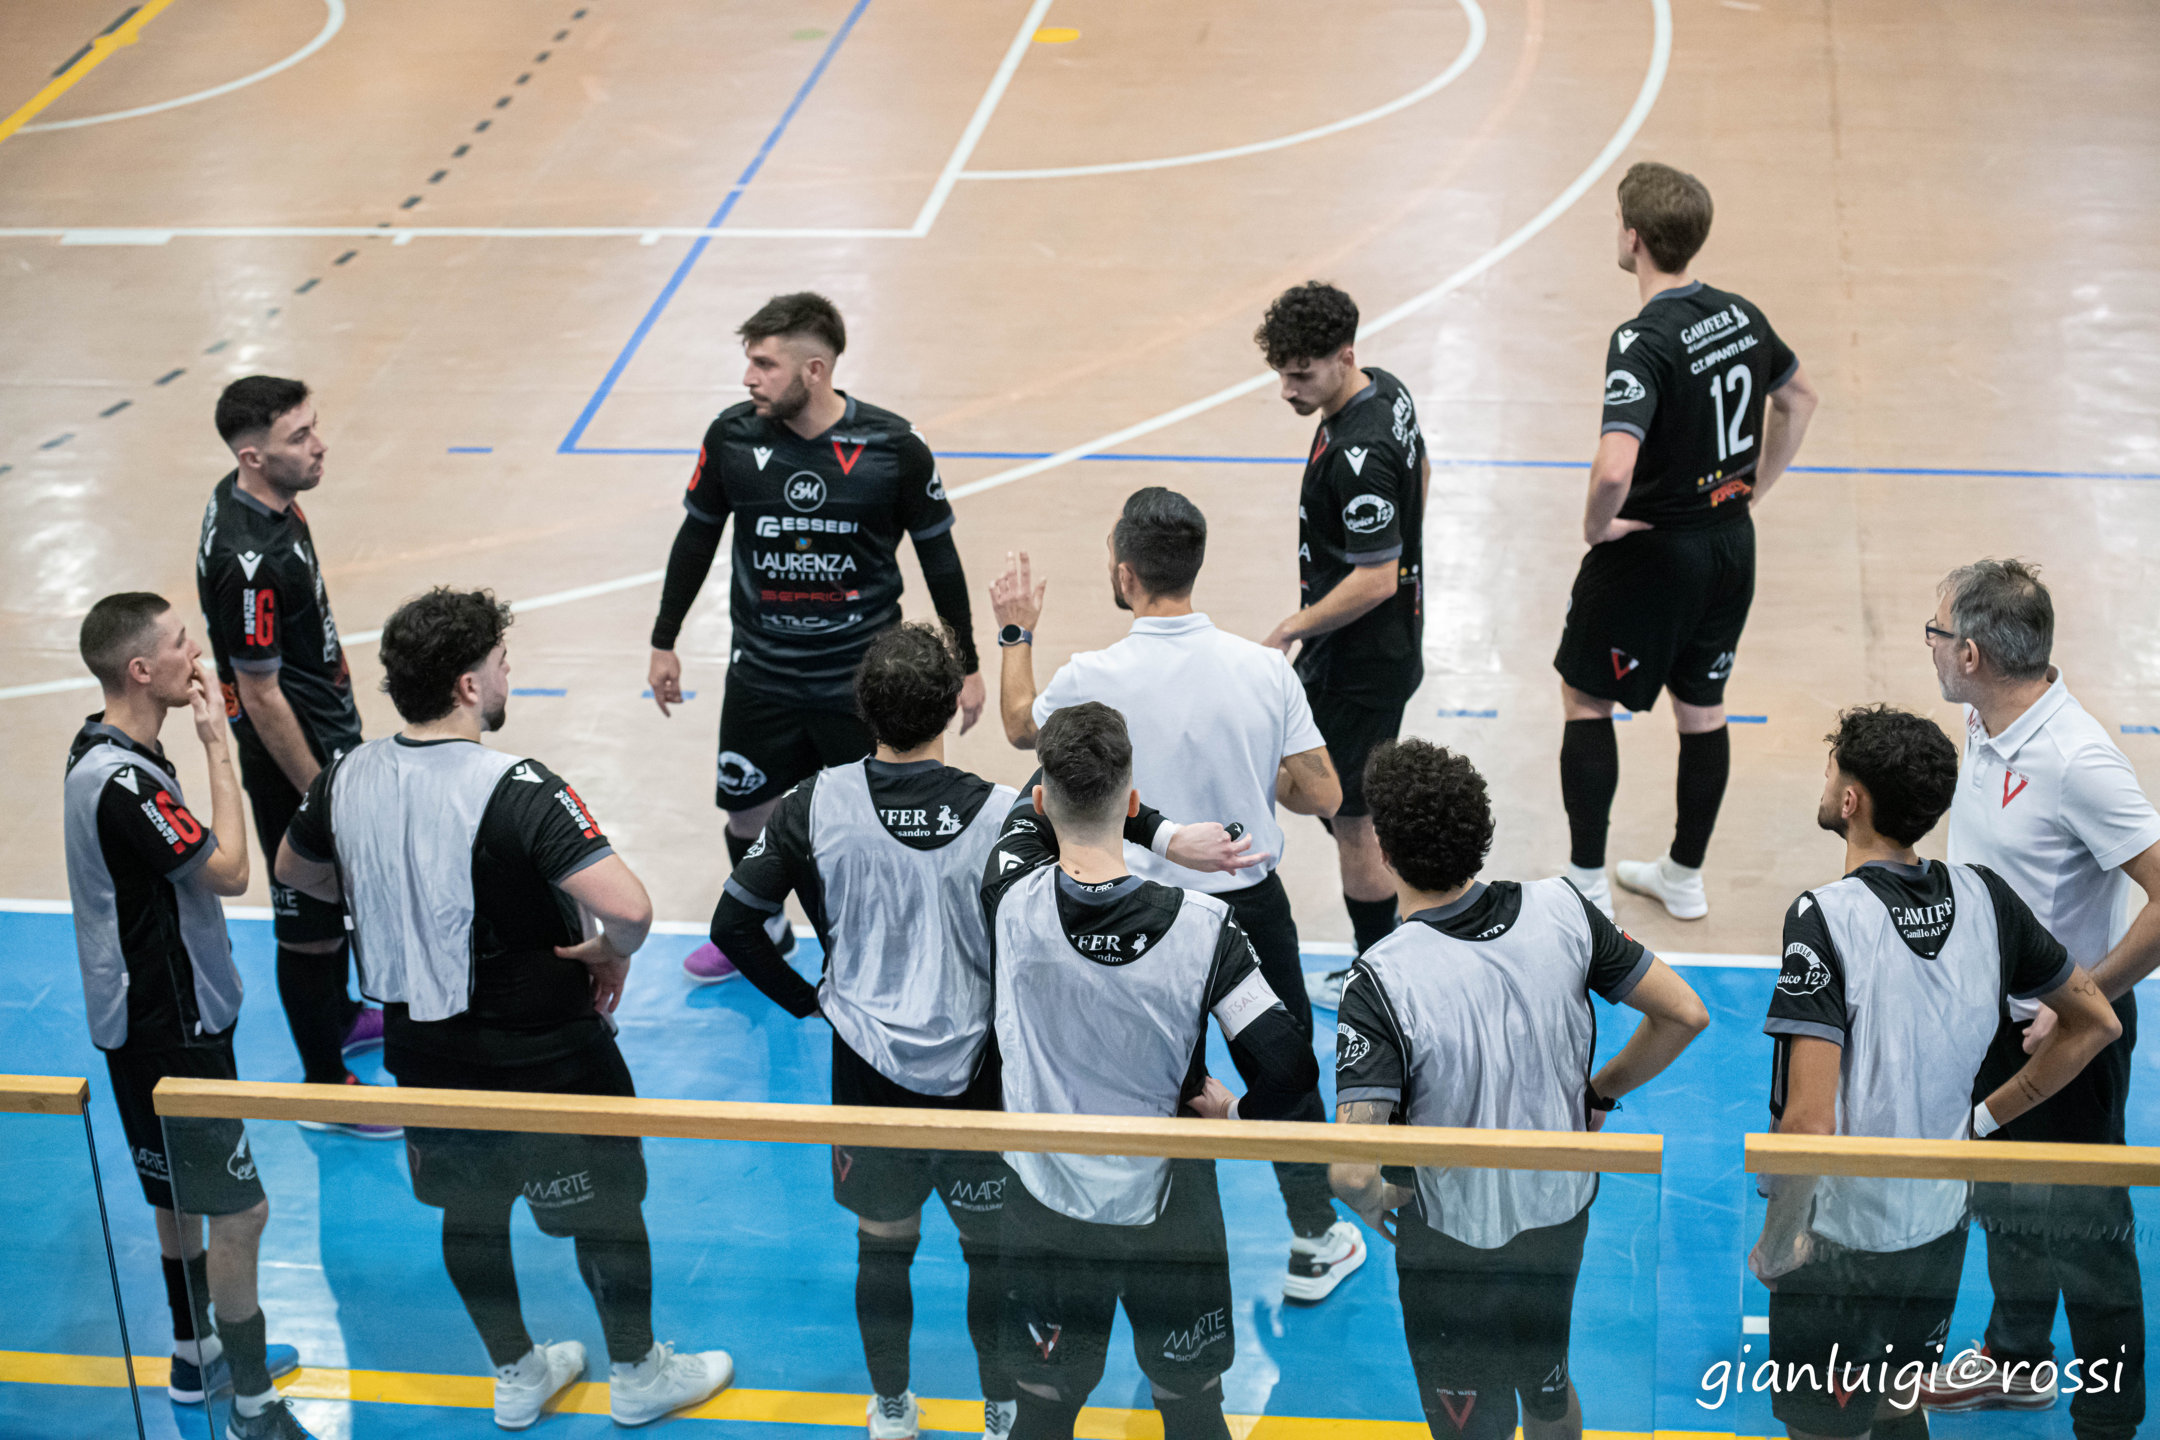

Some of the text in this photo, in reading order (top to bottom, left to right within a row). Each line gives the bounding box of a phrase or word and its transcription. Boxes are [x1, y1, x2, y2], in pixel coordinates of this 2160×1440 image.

[1710, 363, 1754, 461] 12
[782, 517, 858, 533] ESSEBI
[753, 550, 857, 572] LAURENZA
[768, 571, 842, 581] GIOIELLI
[761, 590, 843, 602] SEPRIO
[1804, 970, 1829, 987] 123
[1344, 1042, 1368, 1058] 123
[522, 1170, 592, 1200] MARTE
[1163, 1307, 1225, 1350] MARTE
